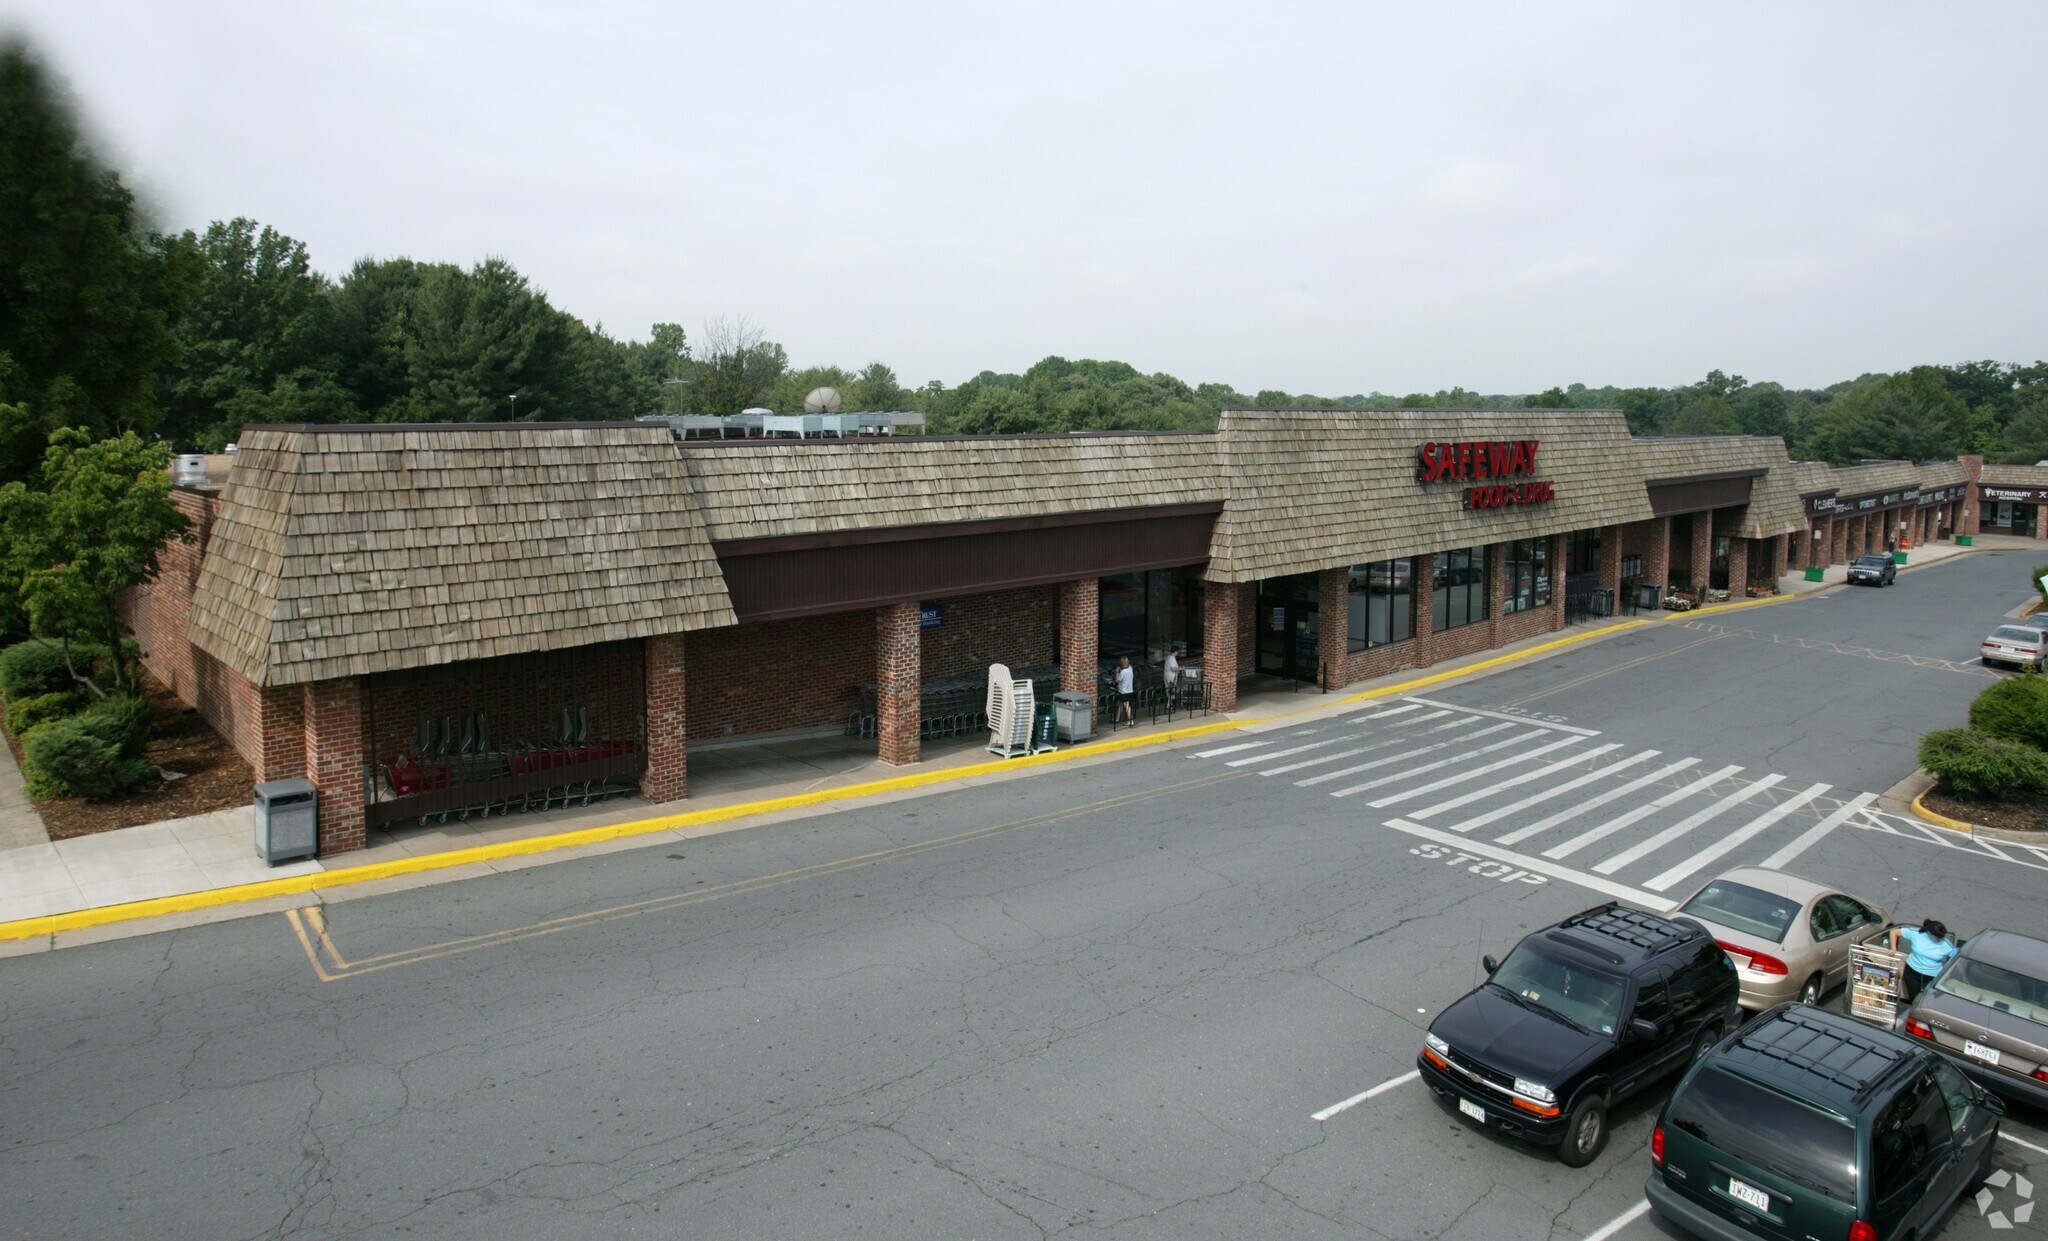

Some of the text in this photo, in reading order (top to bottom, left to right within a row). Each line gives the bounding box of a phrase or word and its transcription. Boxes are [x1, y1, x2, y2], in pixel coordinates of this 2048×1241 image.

[1420, 440, 1540, 482] SAFEWAY
[1470, 480, 1555, 509] FOOD & DRUG
[1984, 487, 2032, 498] VETERINARY
[920, 610, 937, 619] RUST
[1480, 704, 1568, 722] STOP
[1409, 843, 1549, 885] STOP
